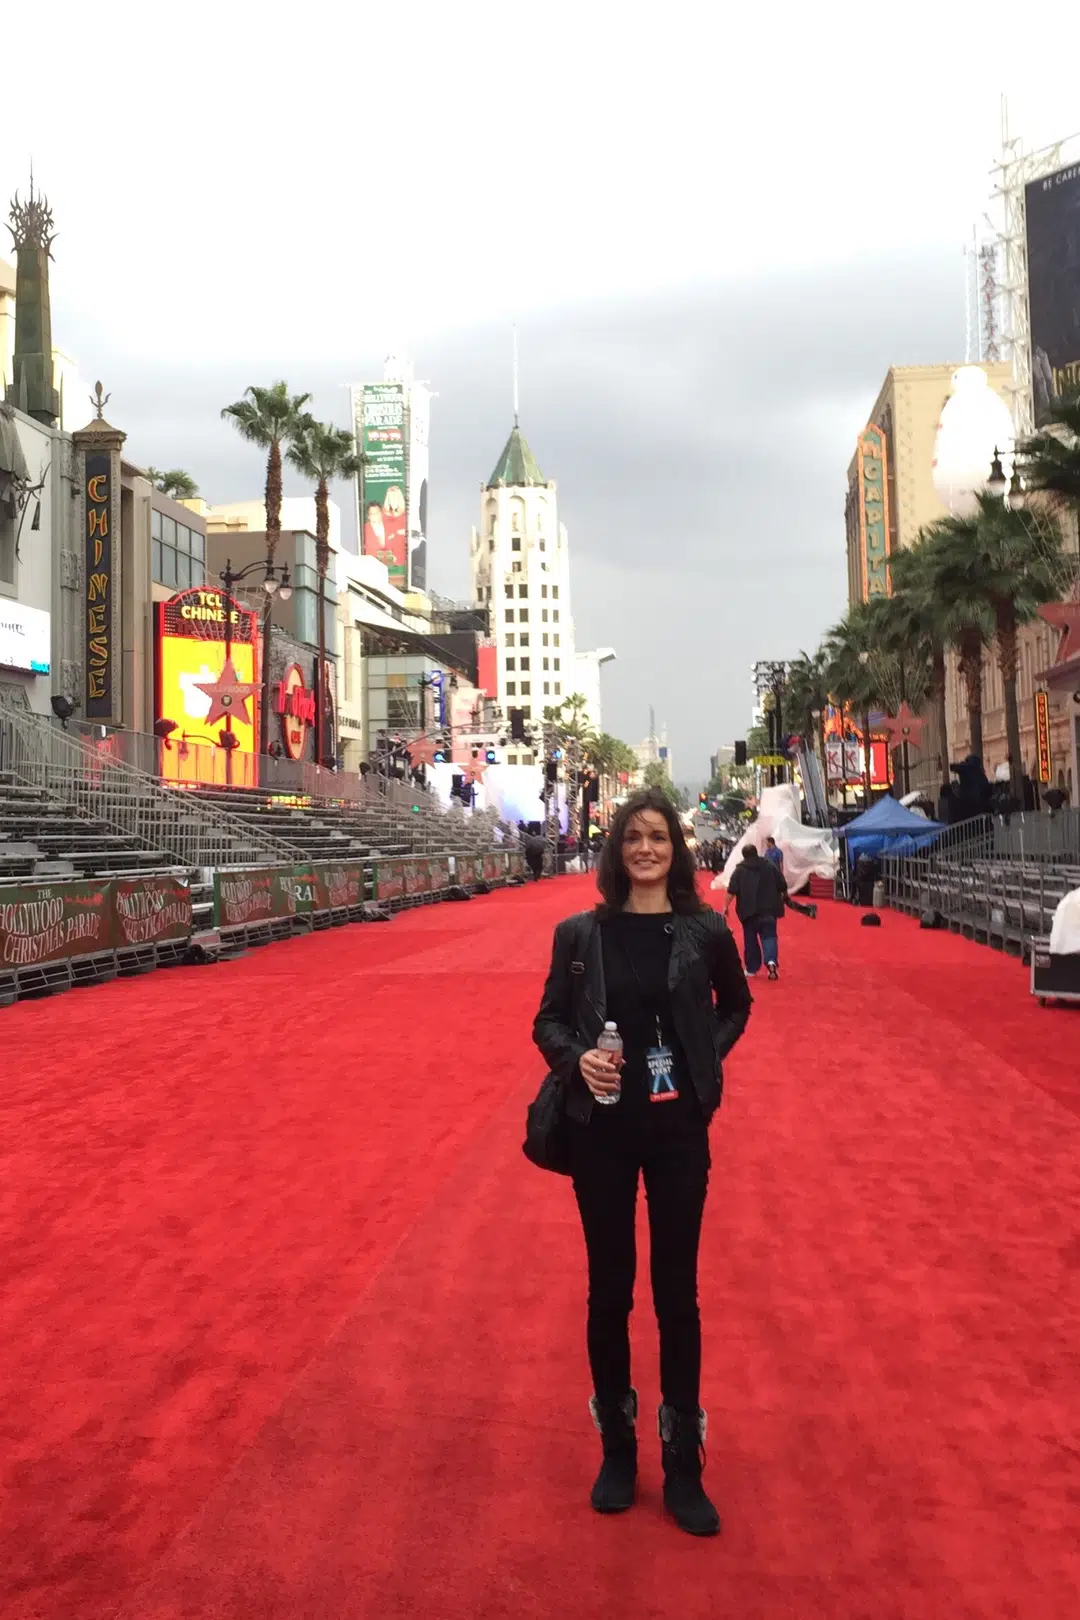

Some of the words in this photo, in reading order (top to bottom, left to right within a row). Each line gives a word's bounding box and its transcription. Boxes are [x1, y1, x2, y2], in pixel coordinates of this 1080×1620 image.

[1043, 178, 1052, 191] BE
[88, 475, 109, 698] CHINESE
[199, 592, 223, 607] TCL
[181, 606, 239, 624] CHINEE
[37, 889, 52, 899] THE
[0, 896, 64, 936] HOLLYWOOD
[4, 921, 65, 963] CHRISTMAS
[66, 913, 101, 943] PARADE
[648, 1058, 673, 1069] SPECIAL
[650, 1066, 672, 1076] EVENT
